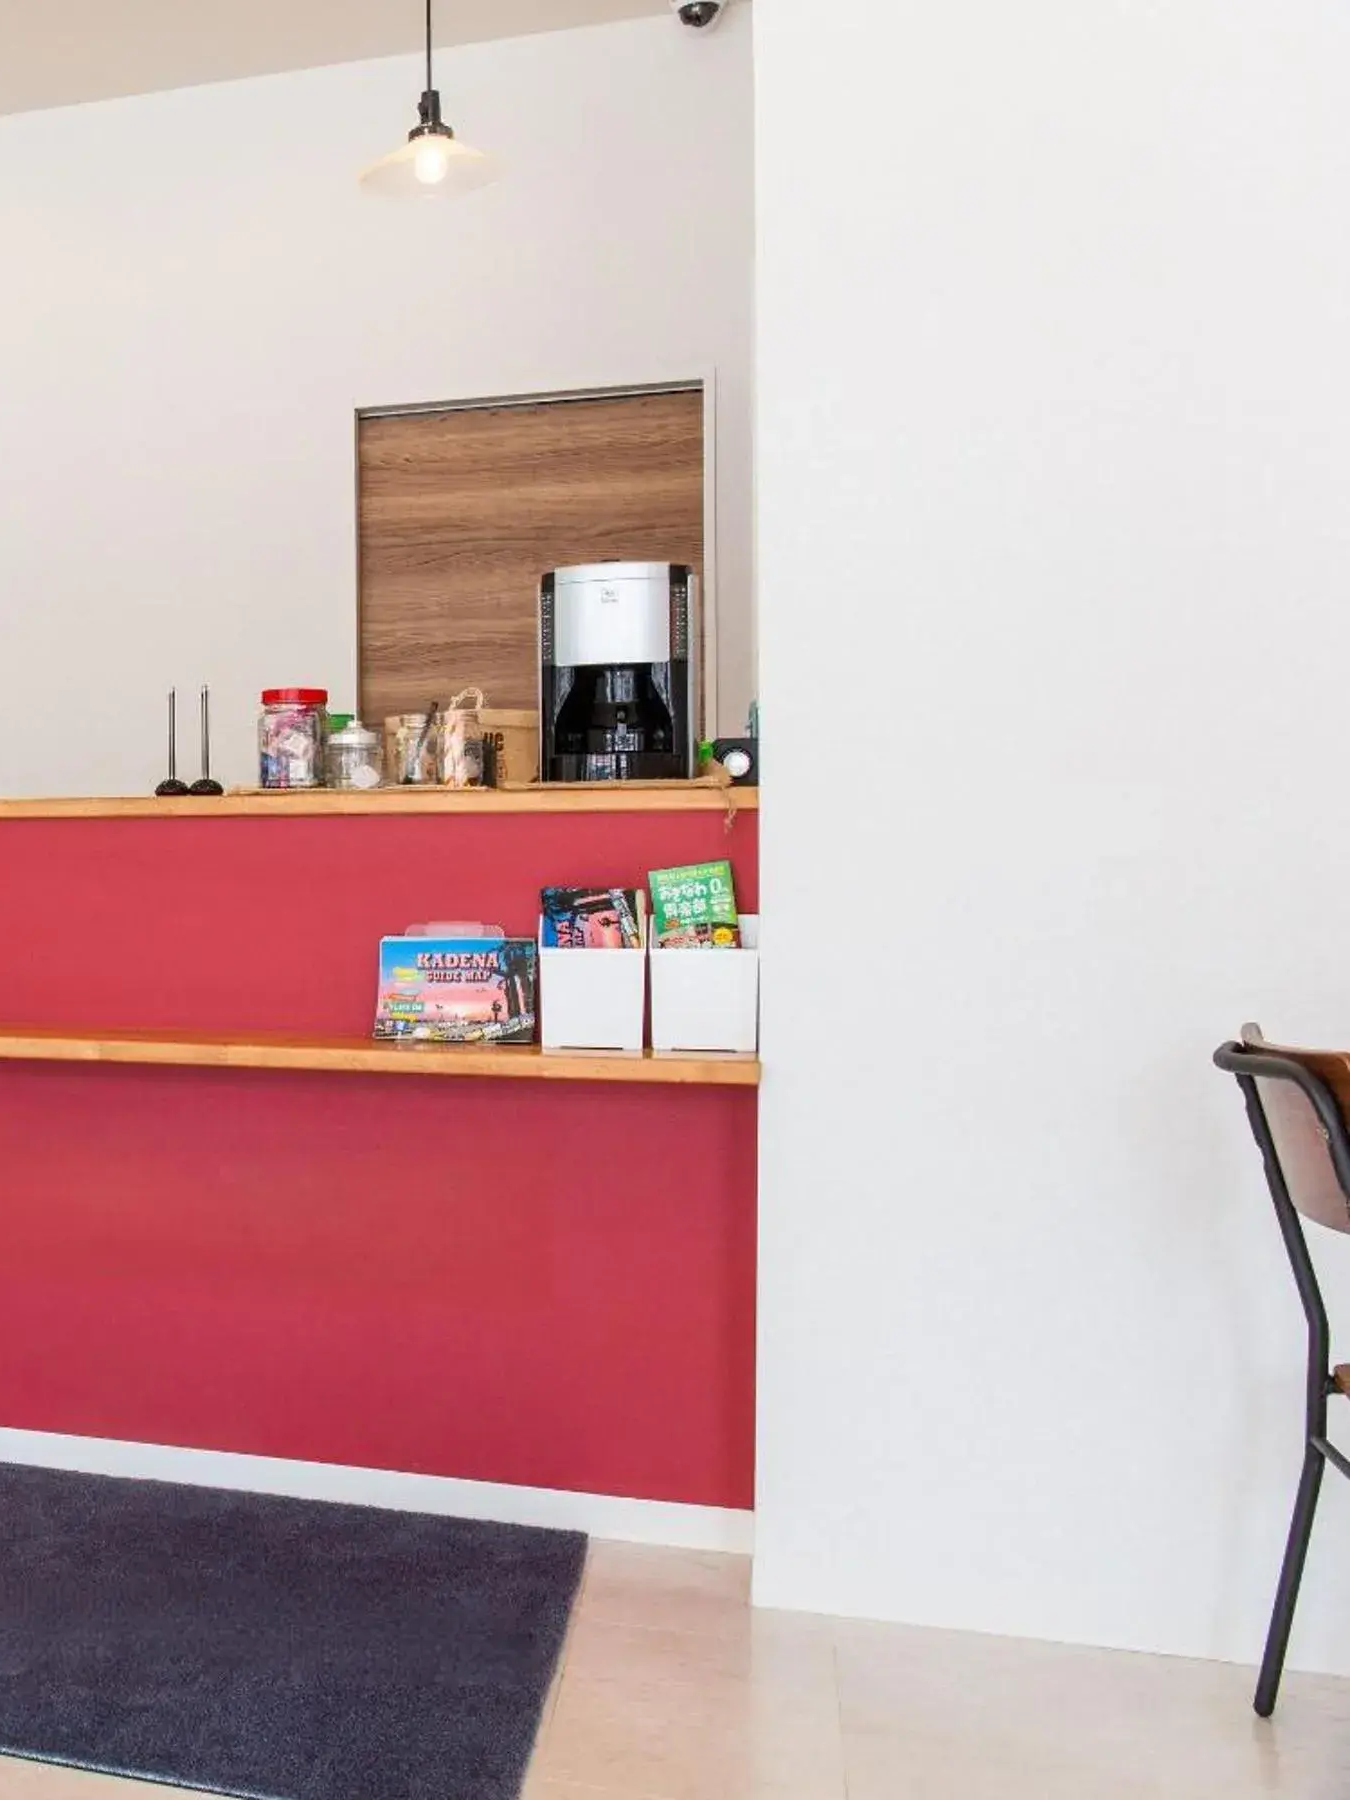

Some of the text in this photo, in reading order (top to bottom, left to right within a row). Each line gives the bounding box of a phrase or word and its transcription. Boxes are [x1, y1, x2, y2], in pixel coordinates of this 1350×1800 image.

[417, 952, 499, 971] KADENA
[426, 970, 462, 983] GUIDE
[465, 970, 492, 983] MAP
